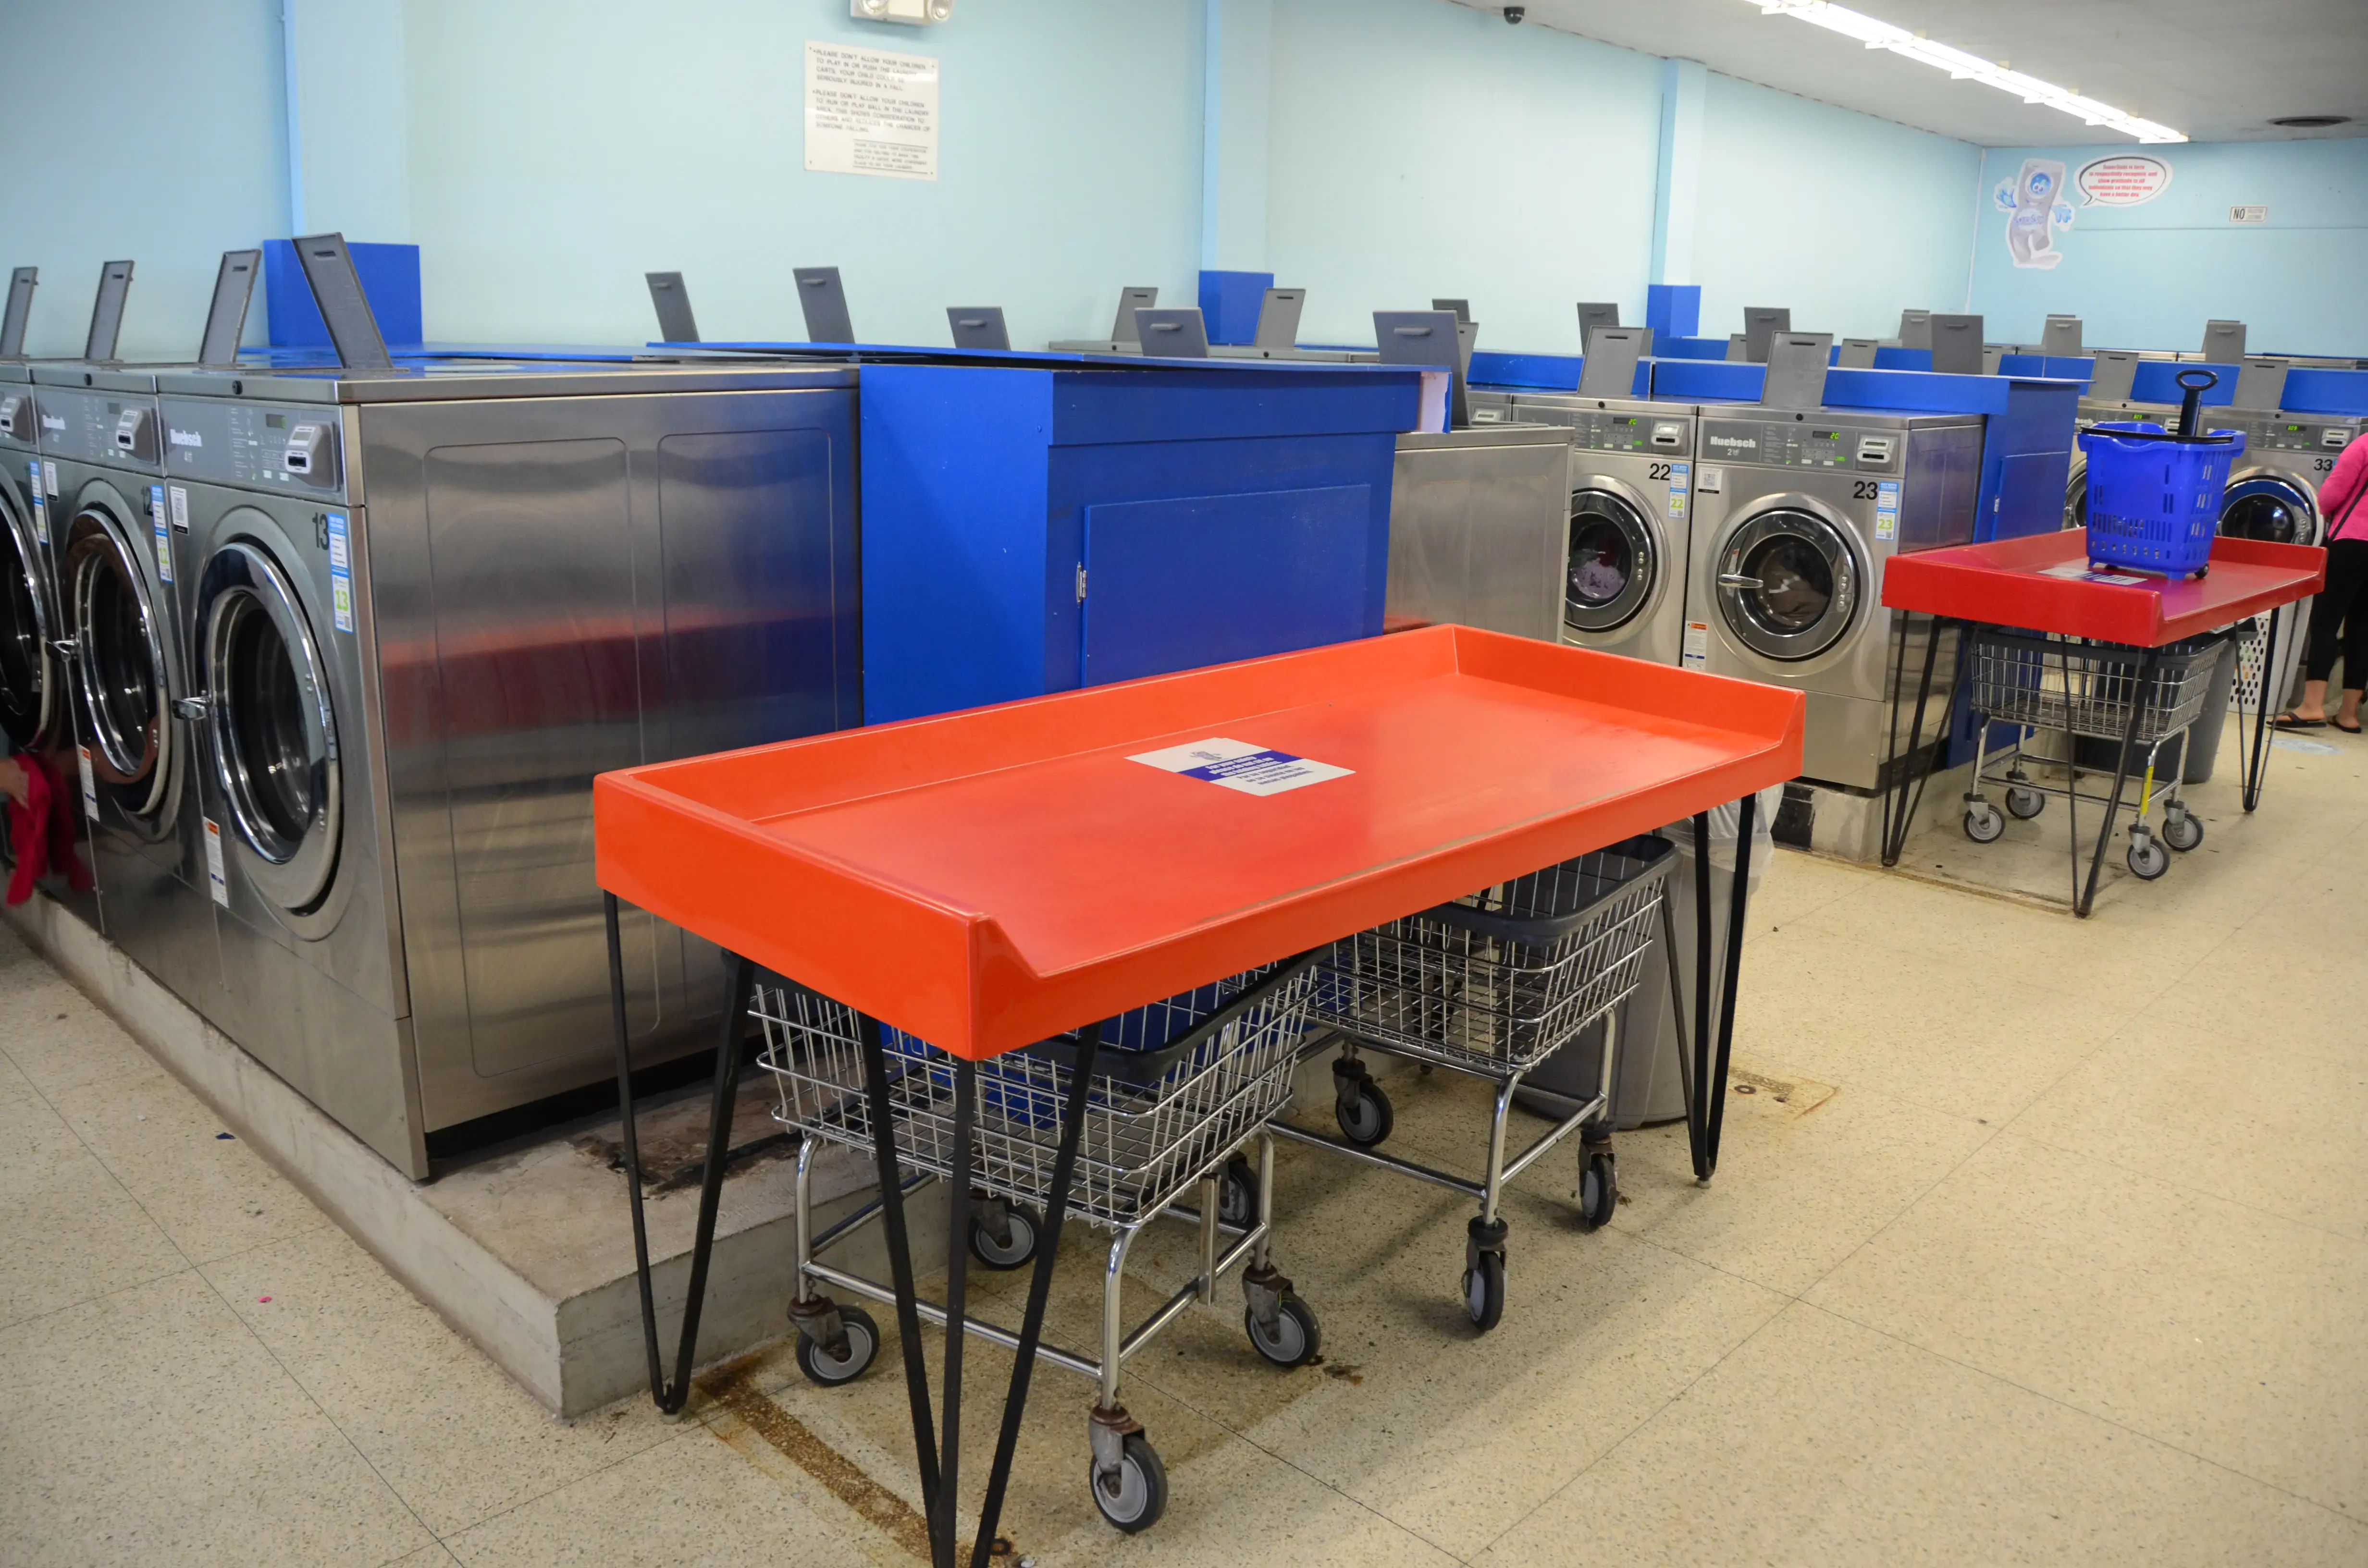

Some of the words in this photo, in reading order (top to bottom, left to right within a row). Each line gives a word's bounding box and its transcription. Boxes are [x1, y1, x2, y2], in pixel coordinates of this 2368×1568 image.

[817, 49, 838, 57] PLEASE
[900, 61, 925, 69] CHILDREN
[2233, 208, 2245, 220] NO
[1711, 436, 1756, 448] Huebsch
[1649, 463, 1670, 480] 22
[2314, 458, 2332, 471] 33
[1853, 481, 1878, 500] 23
[1671, 498, 1684, 508] 22
[312, 512, 329, 550] 13
[1878, 519, 1893, 530] 23
[335, 589, 349, 612] 13
